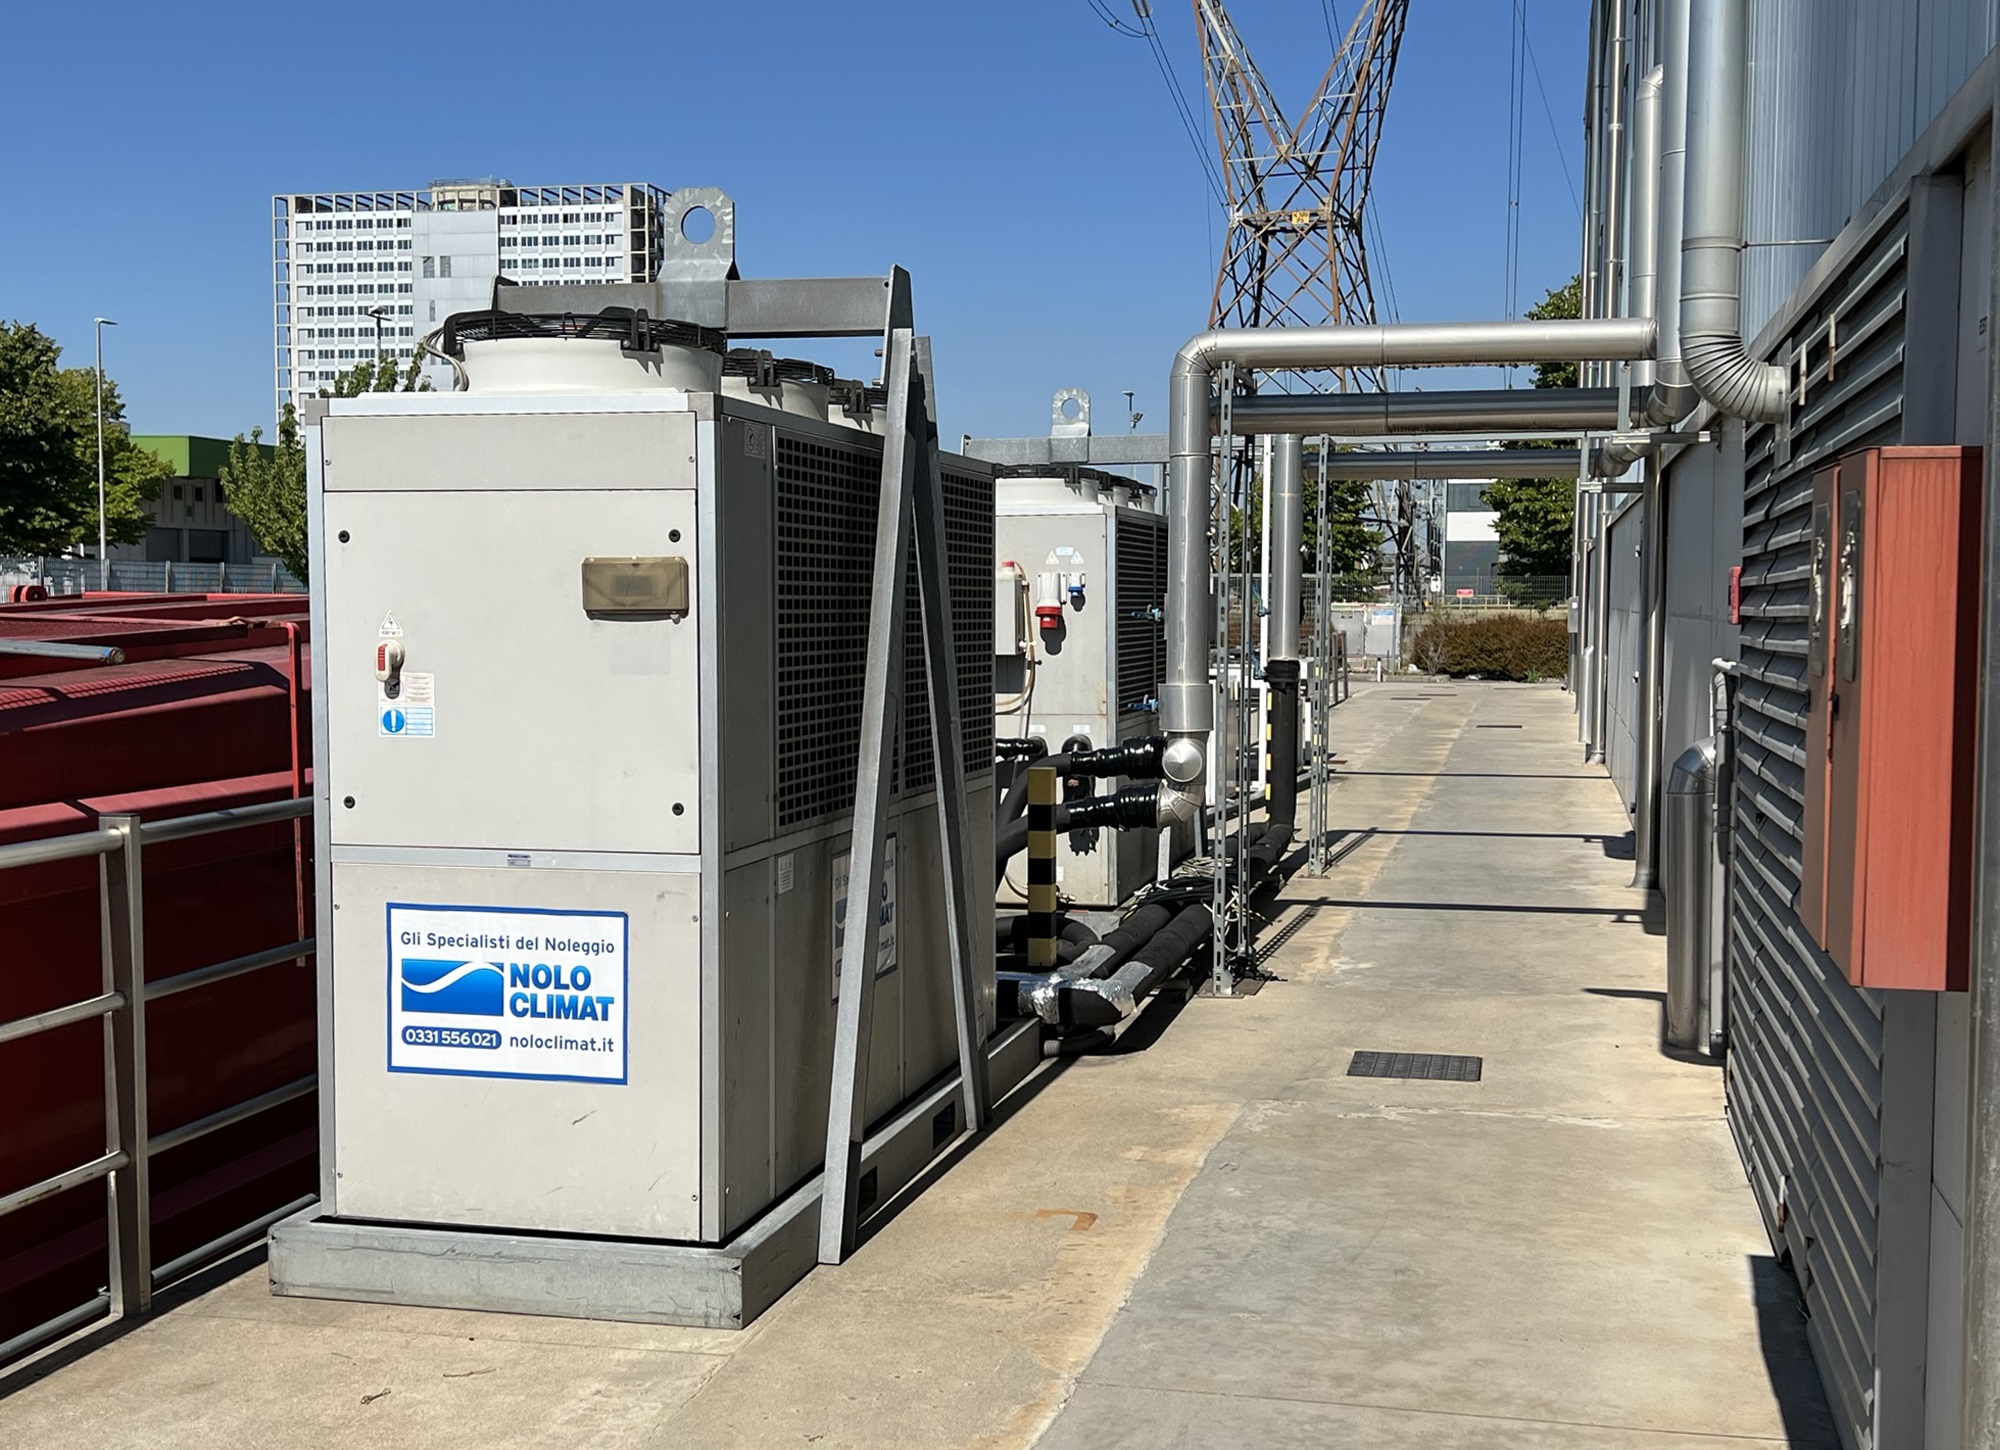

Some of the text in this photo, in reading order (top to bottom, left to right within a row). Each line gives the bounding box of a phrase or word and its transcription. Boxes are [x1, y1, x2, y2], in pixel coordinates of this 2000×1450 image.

[400, 931, 615, 957] Gli Specialisti del Noleggio
[509, 963, 592, 991] NOLO
[509, 991, 615, 1022] CLIMAT
[509, 1034, 614, 1053] noloclimat.it
